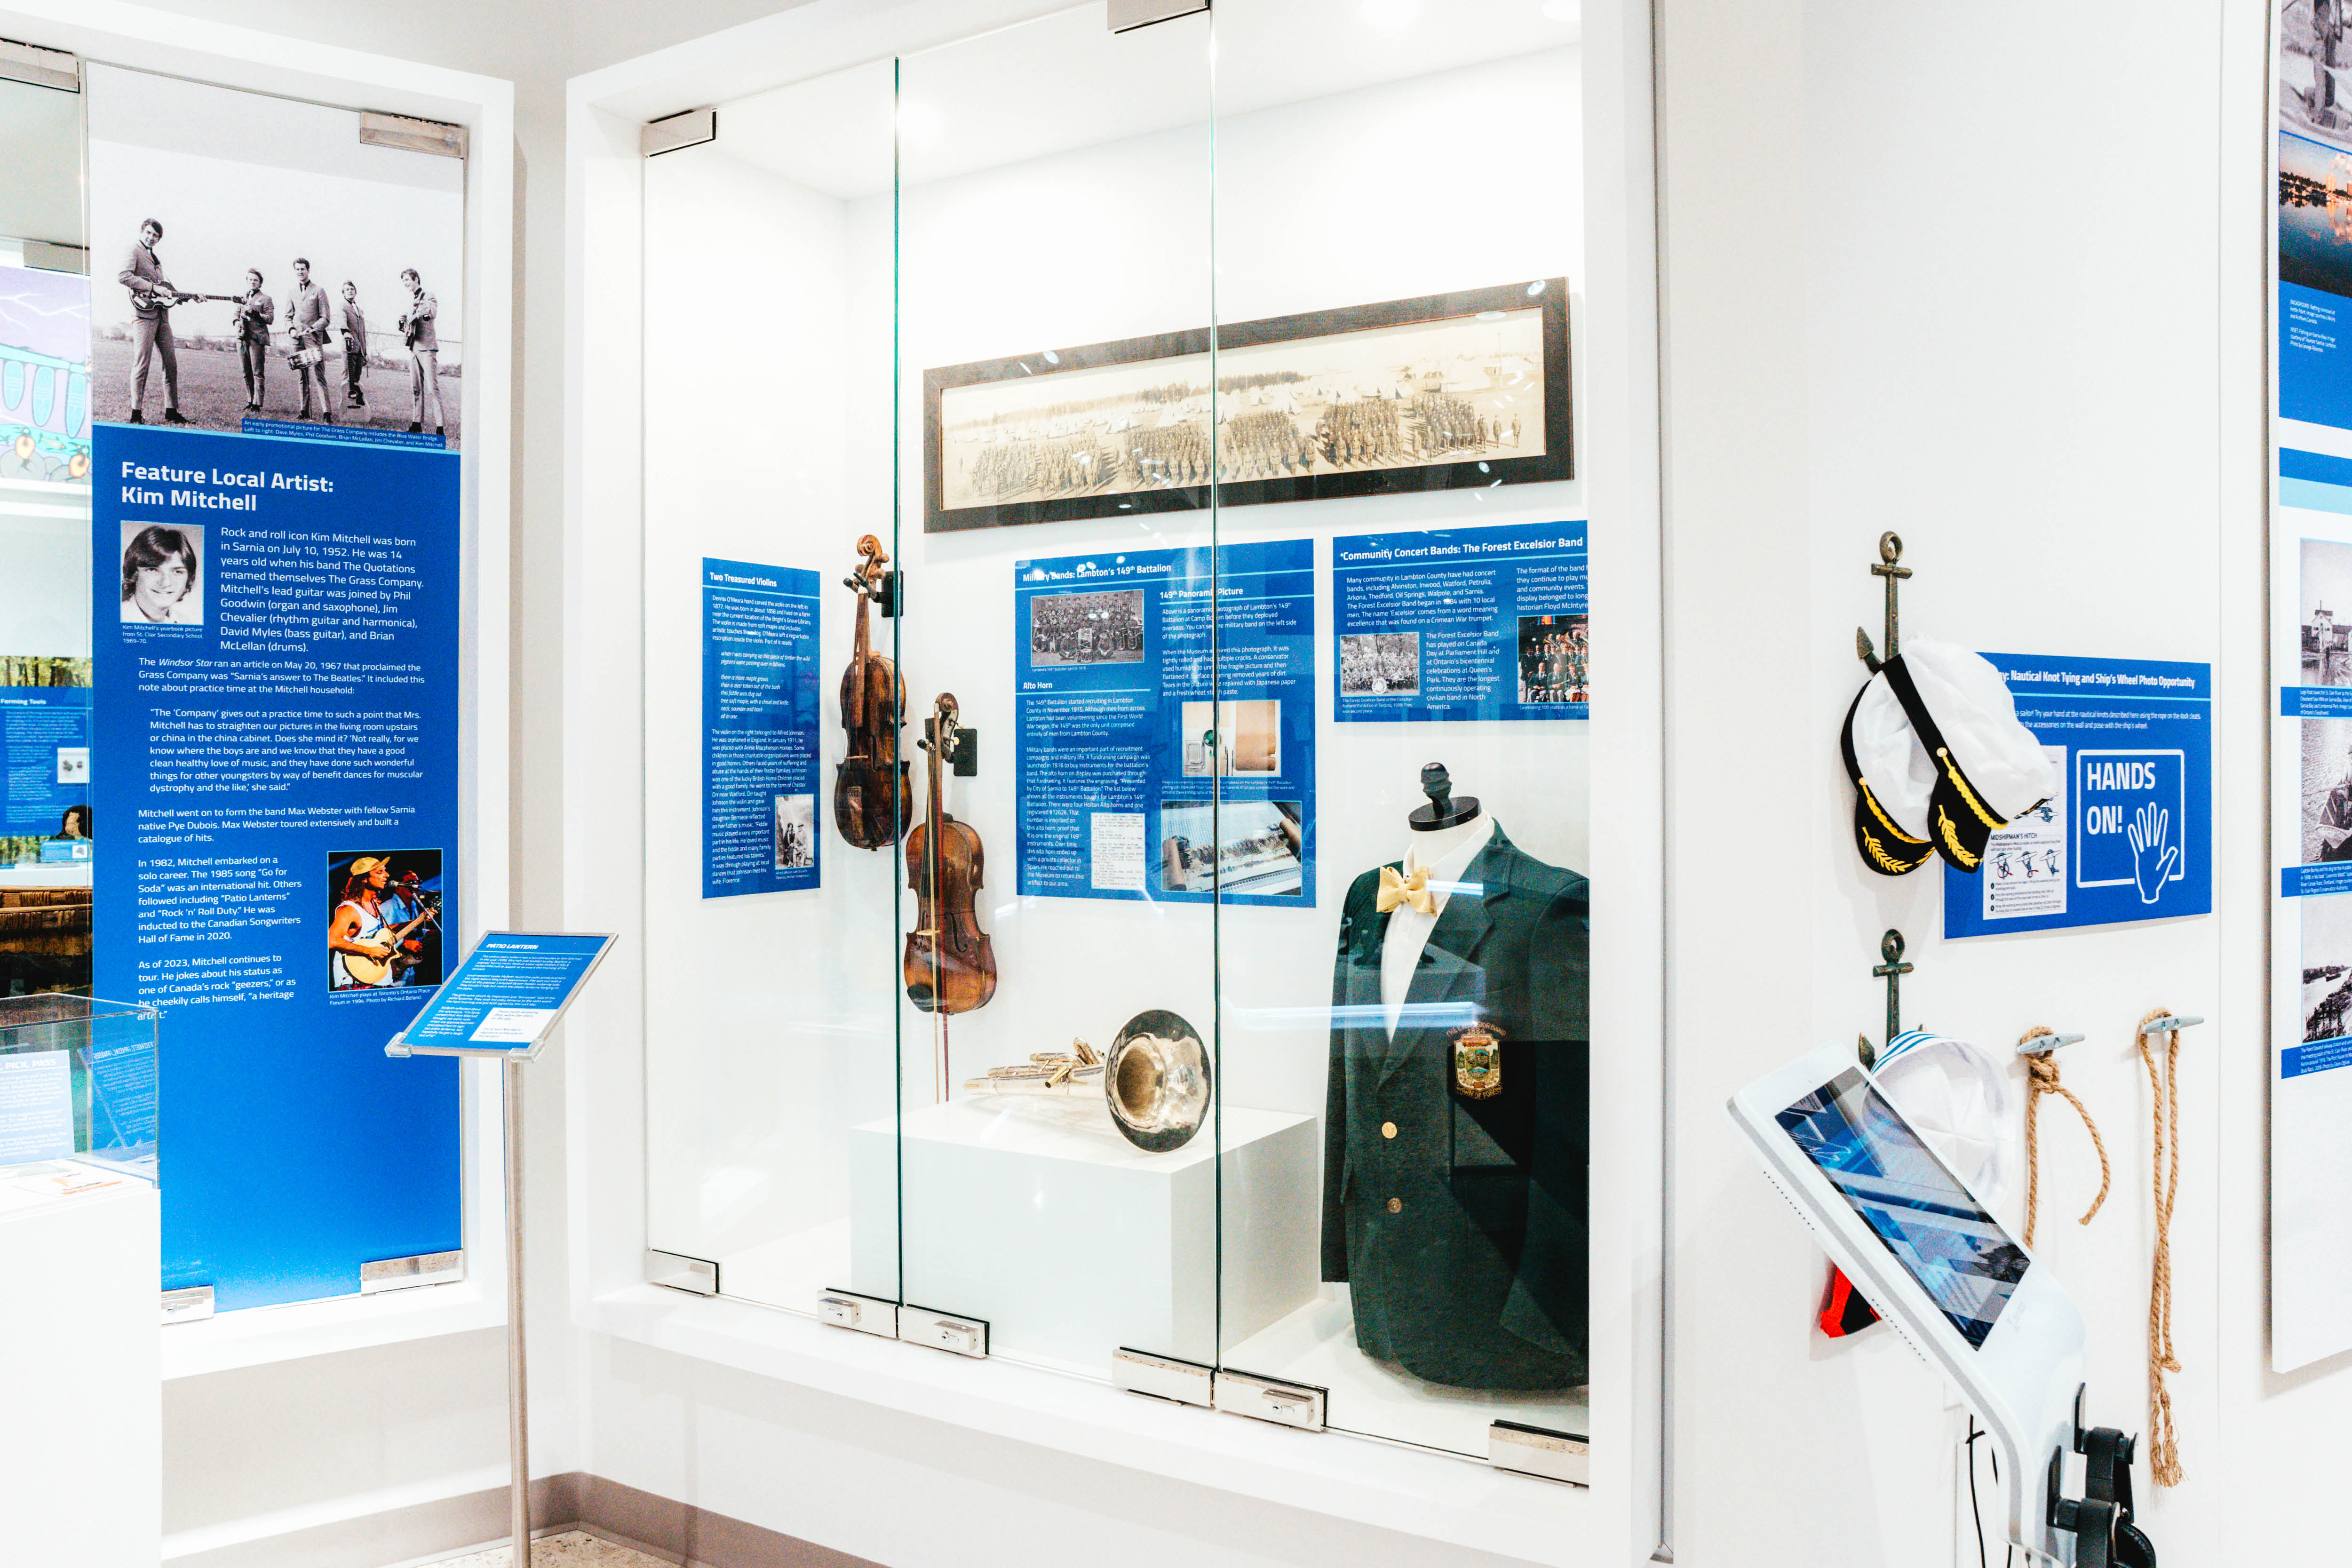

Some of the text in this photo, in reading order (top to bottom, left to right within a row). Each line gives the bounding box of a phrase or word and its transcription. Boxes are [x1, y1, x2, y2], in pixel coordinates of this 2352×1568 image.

[122, 462, 333, 492] Feature Local Artist:
[122, 486, 256, 511] Kim Mitchell
[222, 527, 246, 537] Rock
[248, 529, 267, 538] and
[270, 531, 285, 539] roll
[289, 531, 308, 540] icon
[311, 532, 329, 541] Kim
[333, 533, 370, 544] Mitchell
[395, 537, 415, 546] born
[233, 542, 264, 552] Sarnia
[283, 545, 301, 556] July
[305, 546, 318, 556] 10,
[323, 547, 349, 556] 1952.
[353, 549, 365, 557] He
[1394, 547, 1428, 557] Concert
[1430, 545, 1461, 555] Bands:
[1462, 544, 1480, 553] The
[1482, 542, 1511, 552] Forest
[1514, 539, 1556, 550] Excelsior
[1558, 537, 1582, 547] Band
[221, 557, 415, 573] years old when his band The Quotations
[1023, 572, 1050, 582] Milry
[1051, 571, 1075, 580] Bands:
[1077, 568, 1114, 578] Lambton's
[1137, 564, 1171, 573] Battalion
[710, 572, 777, 587] Two Treasured Violins
[1179, 589, 1212, 598] Panorami
[2011, 670, 2042, 681] Nautical
[2043, 671, 2060, 682] Knot
[2061, 672, 2080, 685] Tying
[2082, 674, 2094, 683] and
[2096, 674, 2116, 685] Ship's
[2117, 674, 2137, 685] Wheel
[2139, 676, 2158, 685] Photo
[2159, 676, 2194, 689] Opportunity
[2087, 762, 2156, 791] HANDS
[2087, 805, 2122, 835] ON!
[32, 1059, 56, 1067] PASS
